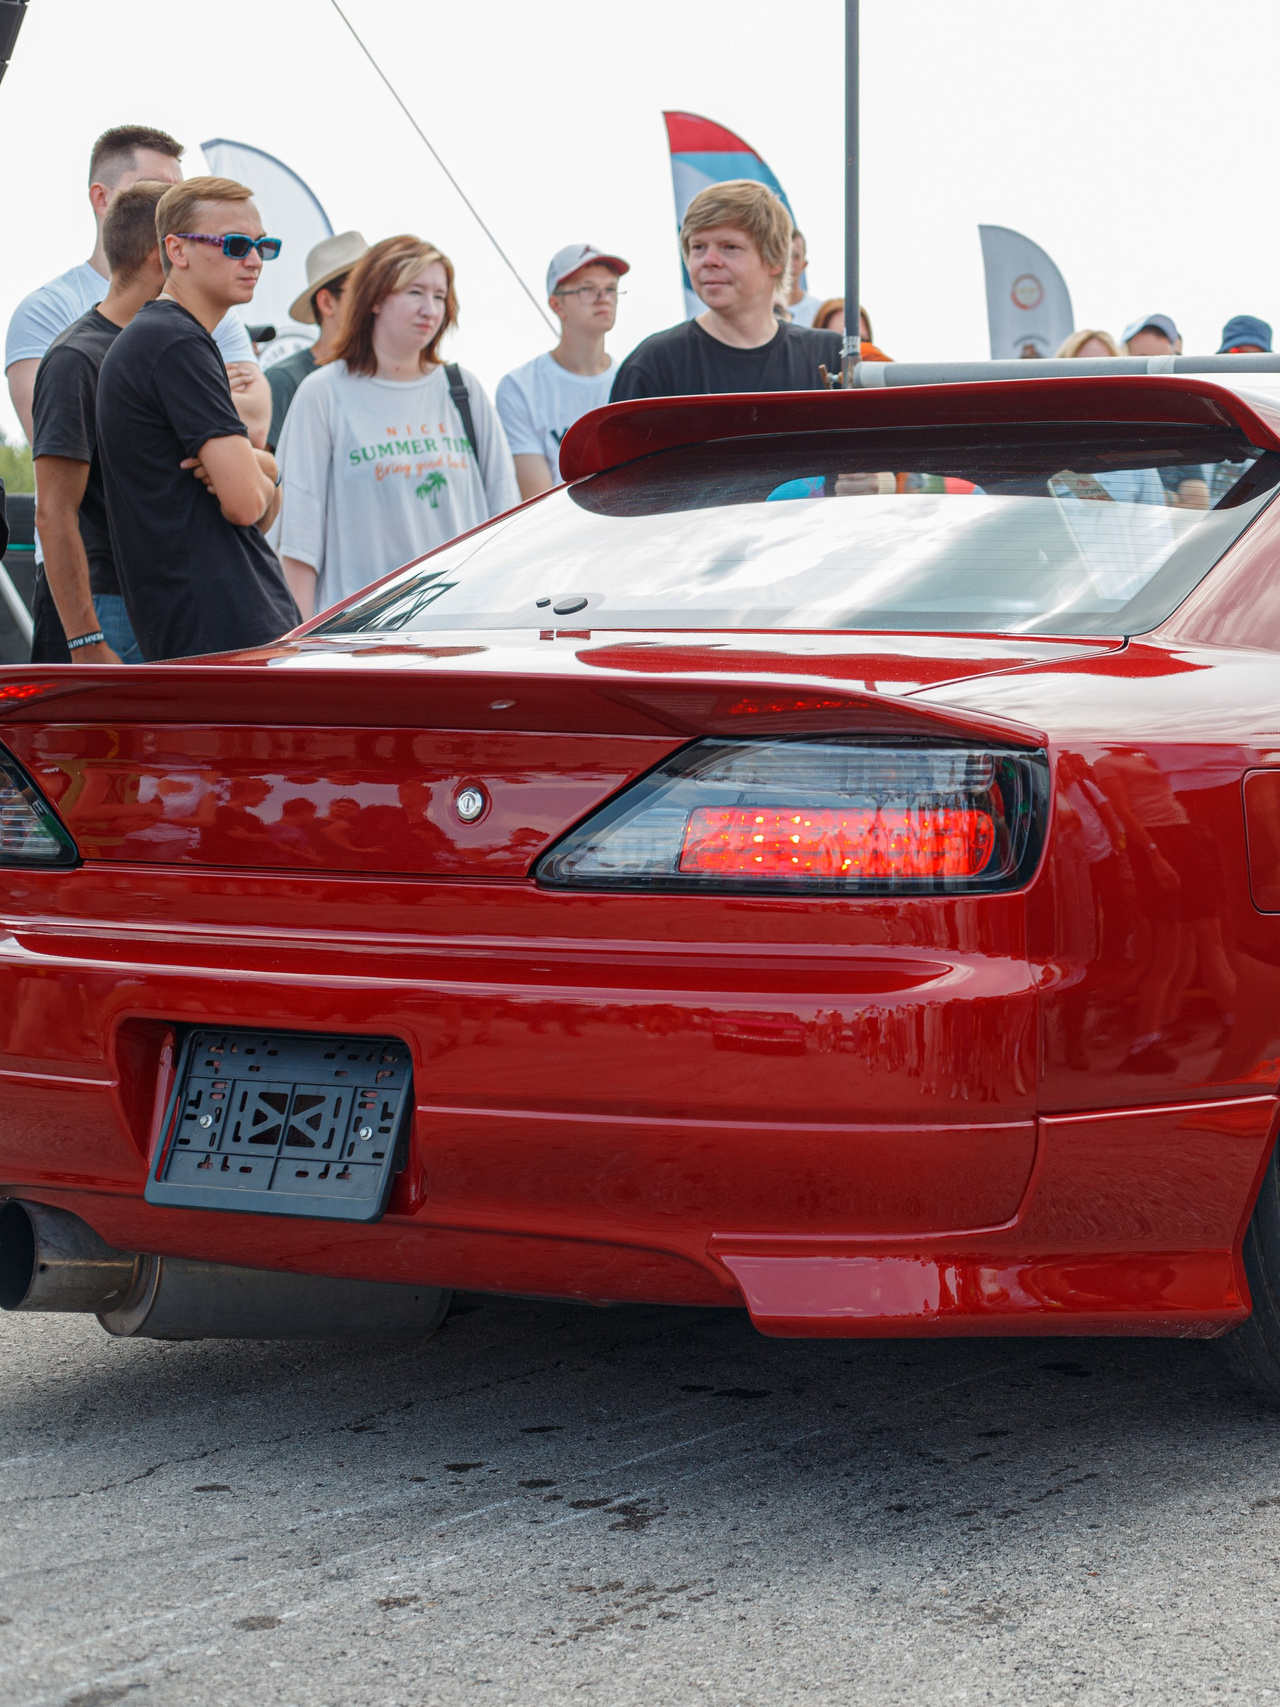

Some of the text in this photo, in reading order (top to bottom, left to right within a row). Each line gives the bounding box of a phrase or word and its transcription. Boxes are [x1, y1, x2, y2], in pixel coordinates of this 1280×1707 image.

[386, 422, 446, 436] NICE
[349, 436, 474, 466] SUMMER TIM
